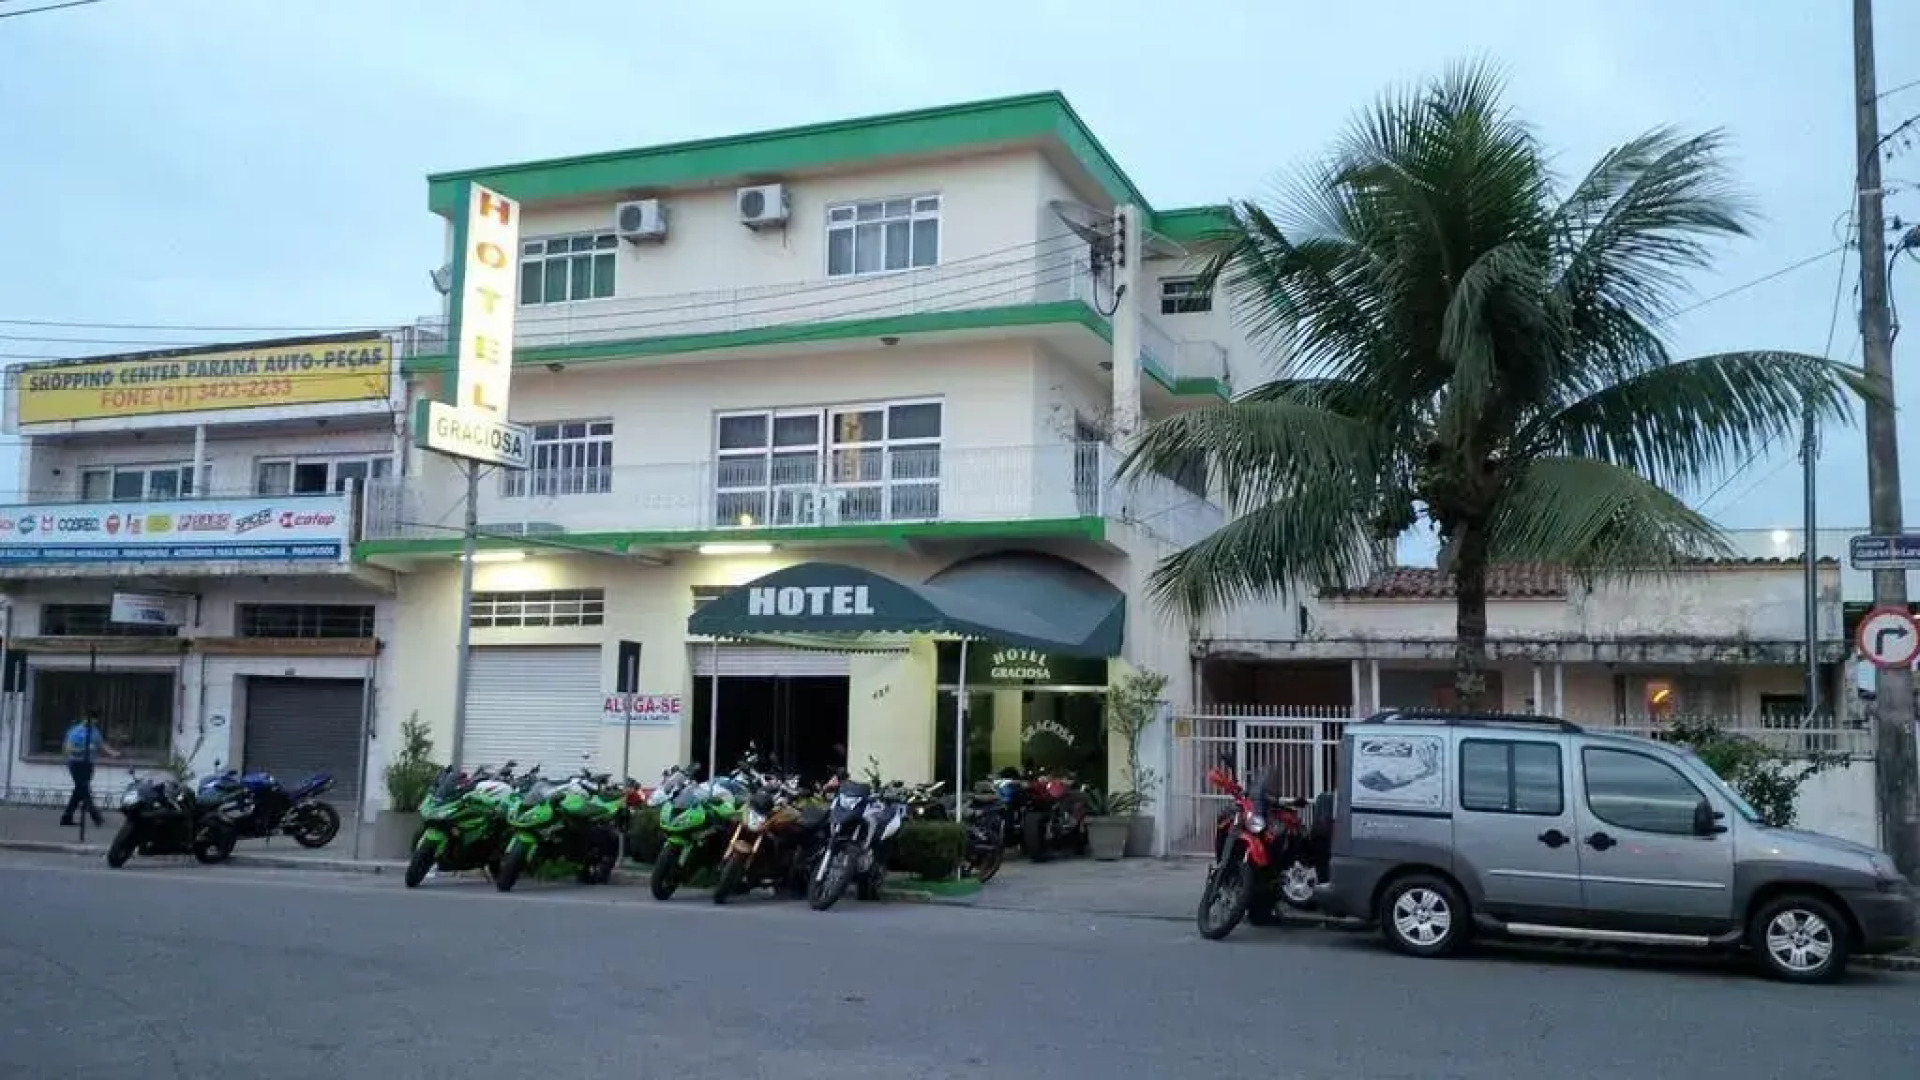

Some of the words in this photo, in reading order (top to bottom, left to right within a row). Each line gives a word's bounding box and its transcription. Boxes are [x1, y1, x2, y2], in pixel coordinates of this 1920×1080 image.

[473, 191, 511, 412] HOTEL
[119, 363, 180, 384] CENTER
[264, 347, 383, 372] AUTO-PEÇAS
[101, 389, 152, 408] FONE
[437, 417, 523, 455] GRACIOSA
[749, 586, 875, 616] HOTEL
[993, 648, 1047, 666] HOTEL
[991, 666, 1051, 679] GRACIOSA
